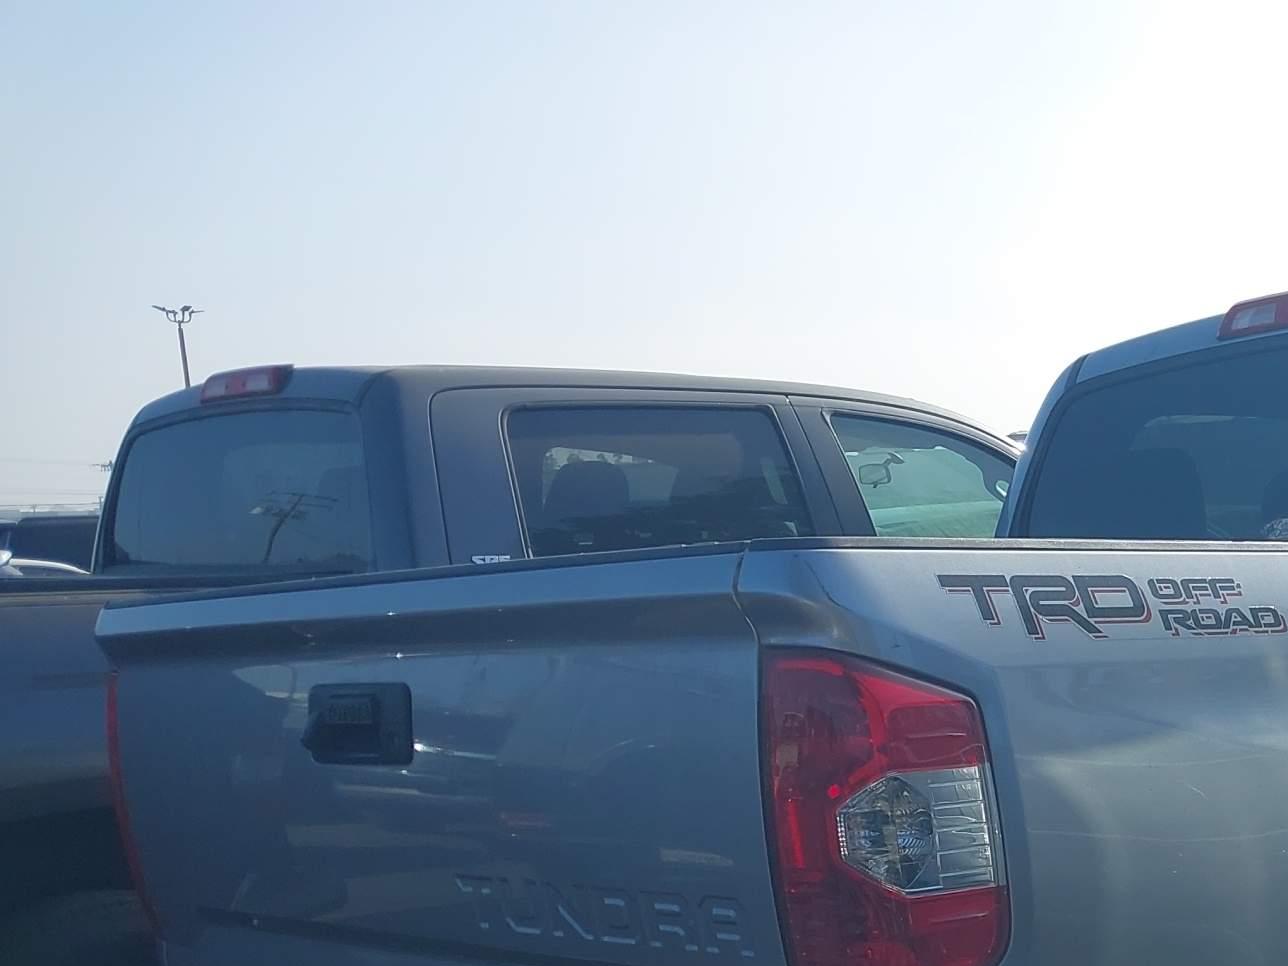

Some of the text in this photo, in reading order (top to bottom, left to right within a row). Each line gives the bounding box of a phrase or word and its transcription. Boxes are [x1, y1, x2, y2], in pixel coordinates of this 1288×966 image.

[935, 573, 1152, 640] TRD
[1147, 577, 1242, 605] OFF
[1158, 605, 1288, 637] ROAD
[455, 873, 756, 958] TUNDRA
